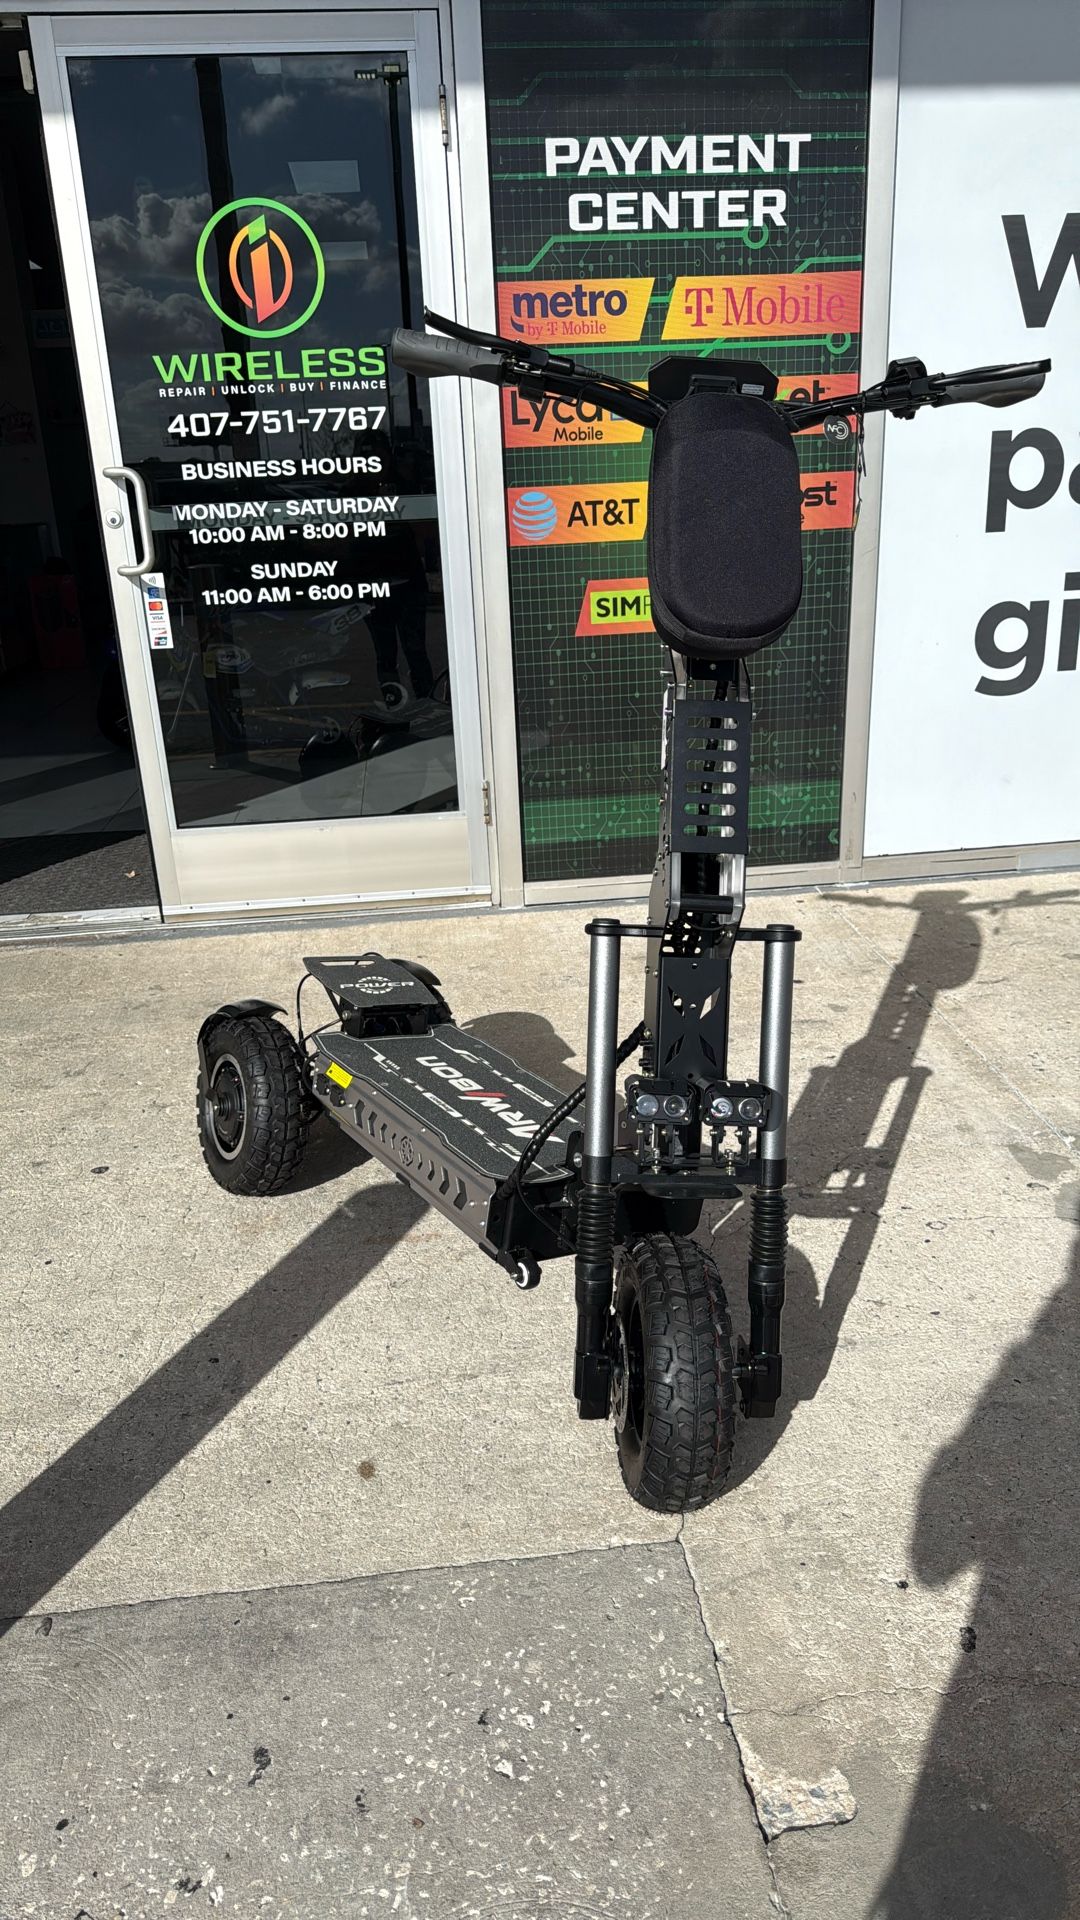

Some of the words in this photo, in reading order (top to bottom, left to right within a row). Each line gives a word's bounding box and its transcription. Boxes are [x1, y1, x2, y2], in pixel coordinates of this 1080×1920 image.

[545, 134, 812, 177] PAYMENT
[568, 189, 788, 232] CENTER
[512, 284, 628, 318] metro
[722, 283, 846, 326] Mobile
[528, 323, 543, 340] by
[562, 320, 607, 336] Mobile
[152, 346, 387, 384] WIRELESS
[159, 386, 207, 398] REPAIR
[221, 383, 275, 395] UNLOCK
[290, 382, 315, 392] BUY
[330, 379, 387, 391] FINANCE
[167, 405, 387, 438] 407-751-7767
[553, 427, 604, 442] Mobile
[181, 459, 297, 481] BUSINESS
[301, 455, 383, 476] HOURS
[985, 427, 1080, 532] p
[172, 500, 269, 522] MONDAY
[285, 496, 400, 517] SATURDAY
[567, 498, 640, 528] AT&T
[189, 526, 246, 545] 10:00
[250, 524, 285, 542] AM
[302, 523, 349, 540] 8:00
[353, 520, 387, 538] PM
[250, 560, 339, 580] SUNDAY
[201, 588, 253, 606] 11:00
[257, 586, 291, 603] AM
[308, 583, 354, 601] 6:00
[358, 581, 391, 598] PM
